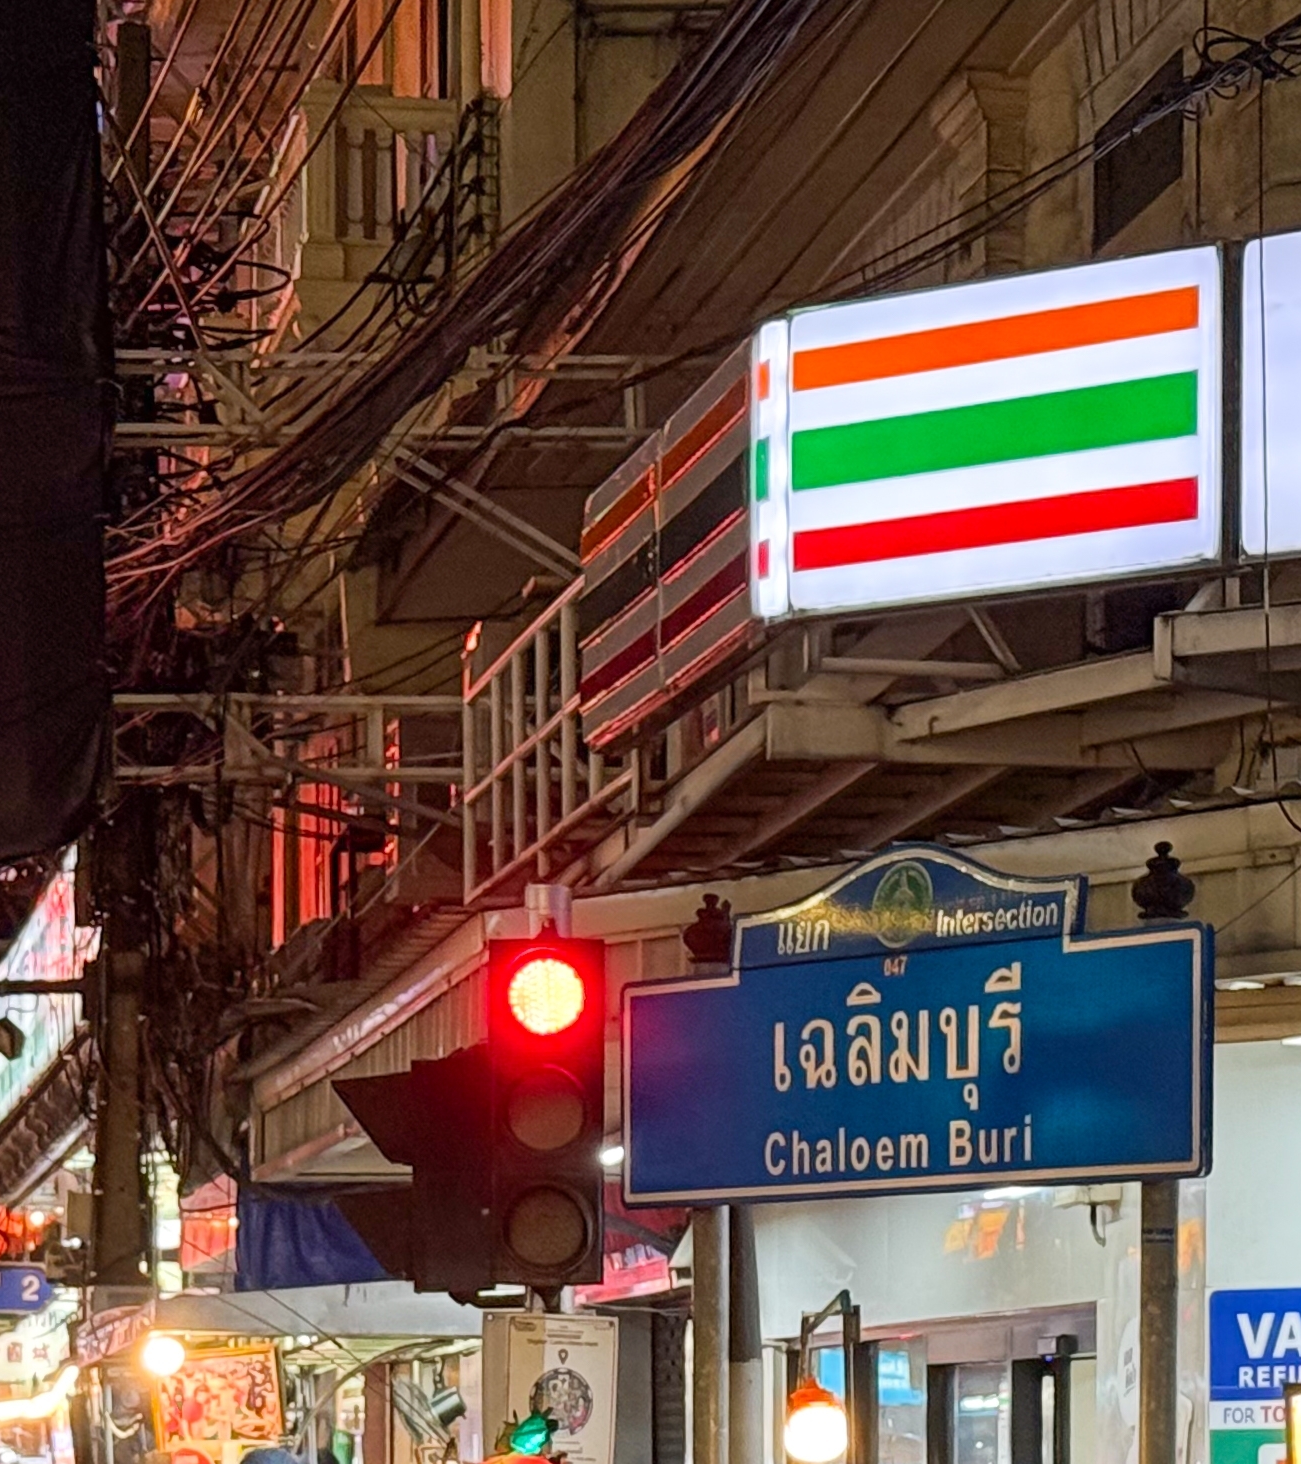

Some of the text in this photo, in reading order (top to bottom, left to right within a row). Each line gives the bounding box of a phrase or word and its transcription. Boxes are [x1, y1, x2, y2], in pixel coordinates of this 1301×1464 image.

[776, 915, 831, 956] แยก
[935, 899, 1059, 939] Intersection
[883, 955, 908, 977] 047
[773, 961, 1023, 1110] เฉลิมบุรี
[764, 1114, 1034, 1177] Chaloem Buri
[1223, 1407, 1256, 1424] FOR
